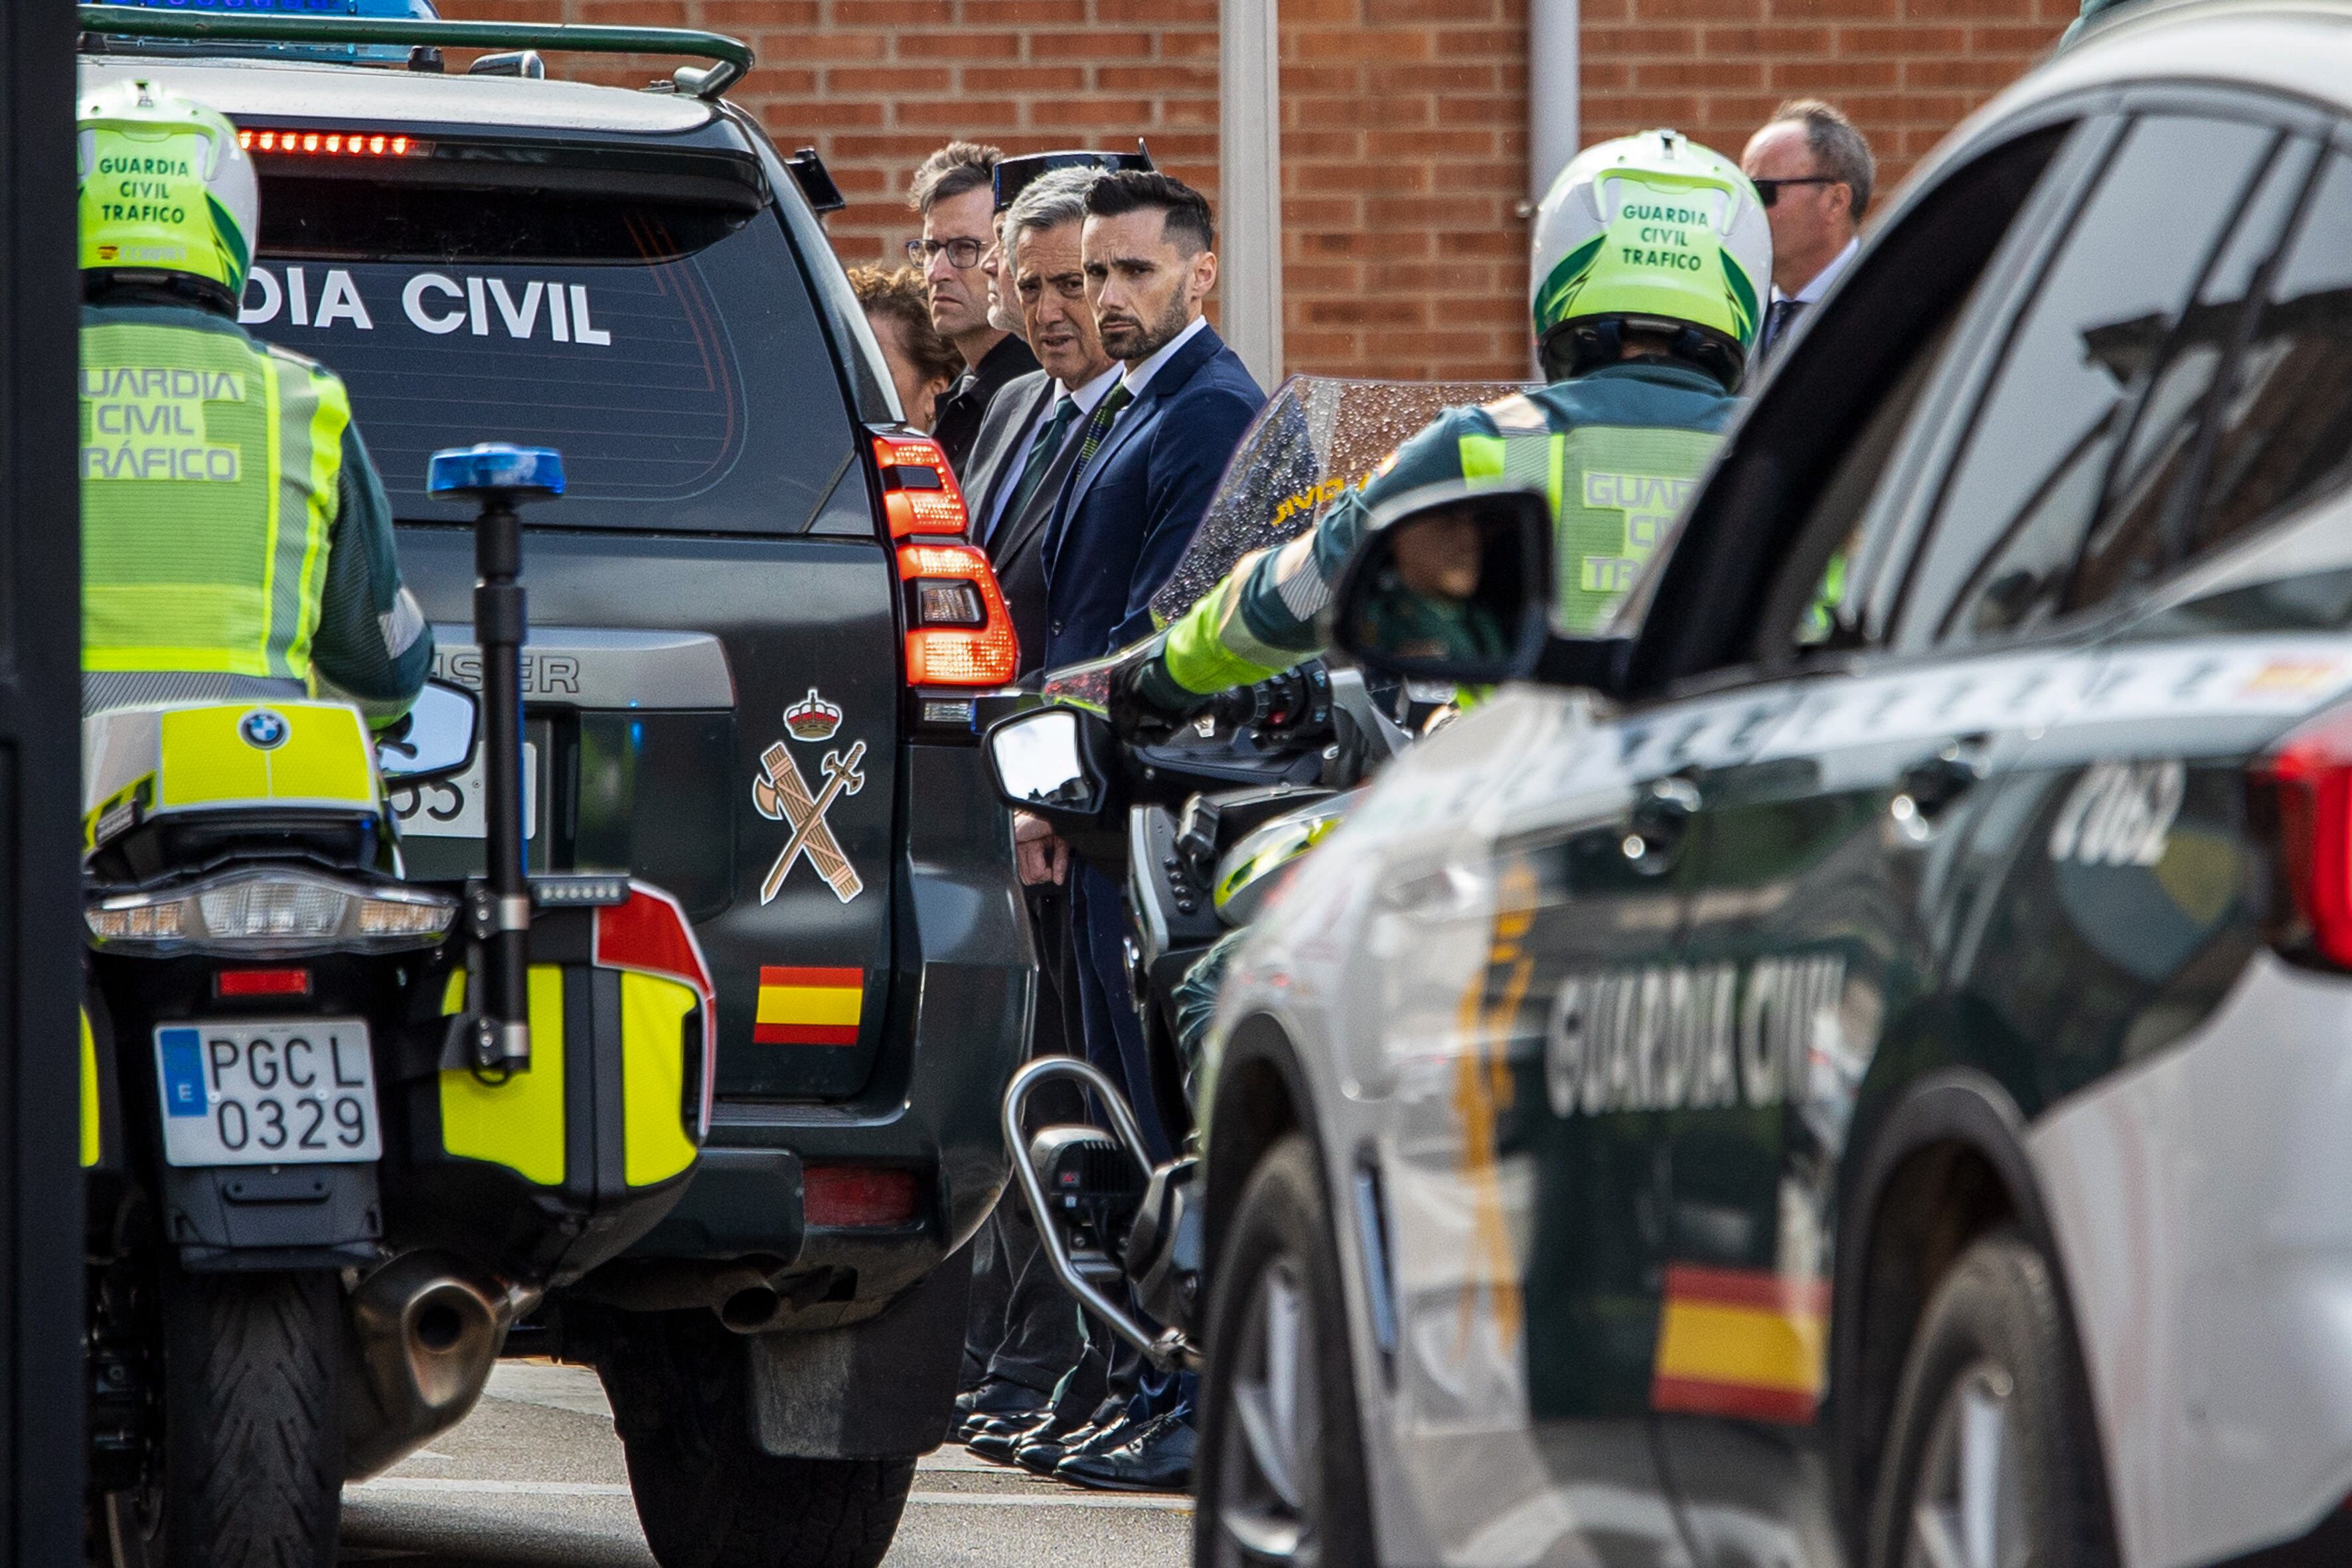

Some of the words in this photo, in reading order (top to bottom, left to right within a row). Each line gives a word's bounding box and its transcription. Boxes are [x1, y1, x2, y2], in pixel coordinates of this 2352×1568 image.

[100, 158, 189, 177] GUARDIA
[120, 181, 170, 199] CIVIL
[102, 204, 185, 224] TRAFICO
[1623, 204, 1709, 227] GUARDIA
[1641, 227, 1688, 247] CIVIL
[1622, 248, 1701, 272] TRAFICO
[238, 266, 374, 329] DIA
[402, 272, 611, 346] CIVIL
[79, 368, 239, 400] UARDIA
[98, 404, 195, 435] CIVIL
[80, 439, 236, 481] RÁFICO
[178, 1083, 193, 1103] E
[217, 1097, 365, 1151] 0329
